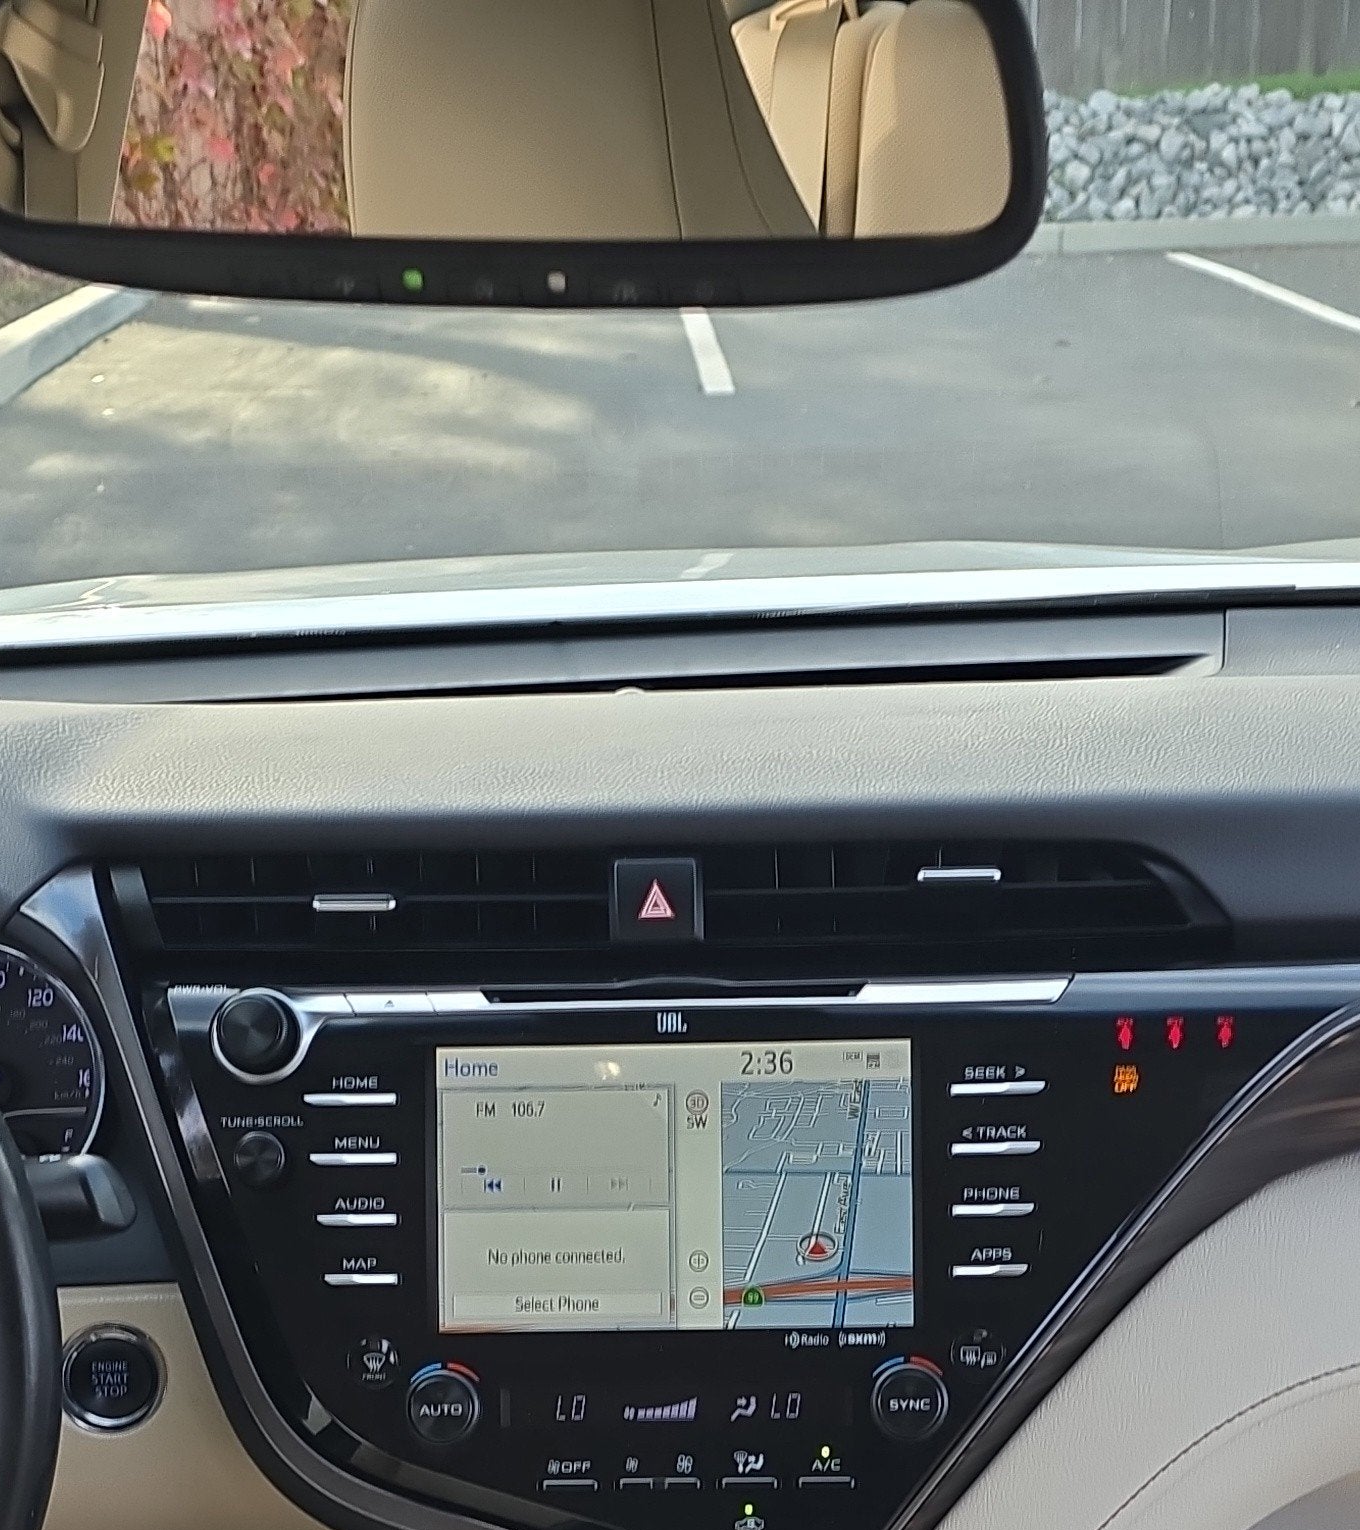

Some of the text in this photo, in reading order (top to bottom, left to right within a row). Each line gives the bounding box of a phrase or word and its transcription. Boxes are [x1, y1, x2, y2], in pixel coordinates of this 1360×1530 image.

[28, 989, 54, 1006] 120
[444, 1058, 498, 1077] Home
[740, 1051, 794, 1075] 2:36
[964, 1067, 1006, 1079] SEEK
[332, 1076, 379, 1089] HOME
[476, 1102, 496, 1118] FM
[686, 1116, 708, 1130] SW
[977, 1126, 1027, 1139] TRACK
[334, 1137, 381, 1149] MENU
[963, 1187, 1021, 1200] PHONE
[335, 1197, 385, 1211] AUDIO
[488, 1248, 626, 1268] No phone connected.
[971, 1248, 1012, 1261] APPS
[342, 1258, 378, 1270] MAP
[515, 1296, 599, 1312] Select Phone
[801, 1332, 830, 1346] Radio
[92, 1360, 127, 1371] ENGINE
[92, 1372, 128, 1385] START
[95, 1385, 127, 1399] STOP
[419, 1403, 463, 1417] AUTO
[889, 1398, 931, 1411] SYNC
[561, 1461, 591, 1474] OFF
[812, 1459, 841, 1472] A/C
